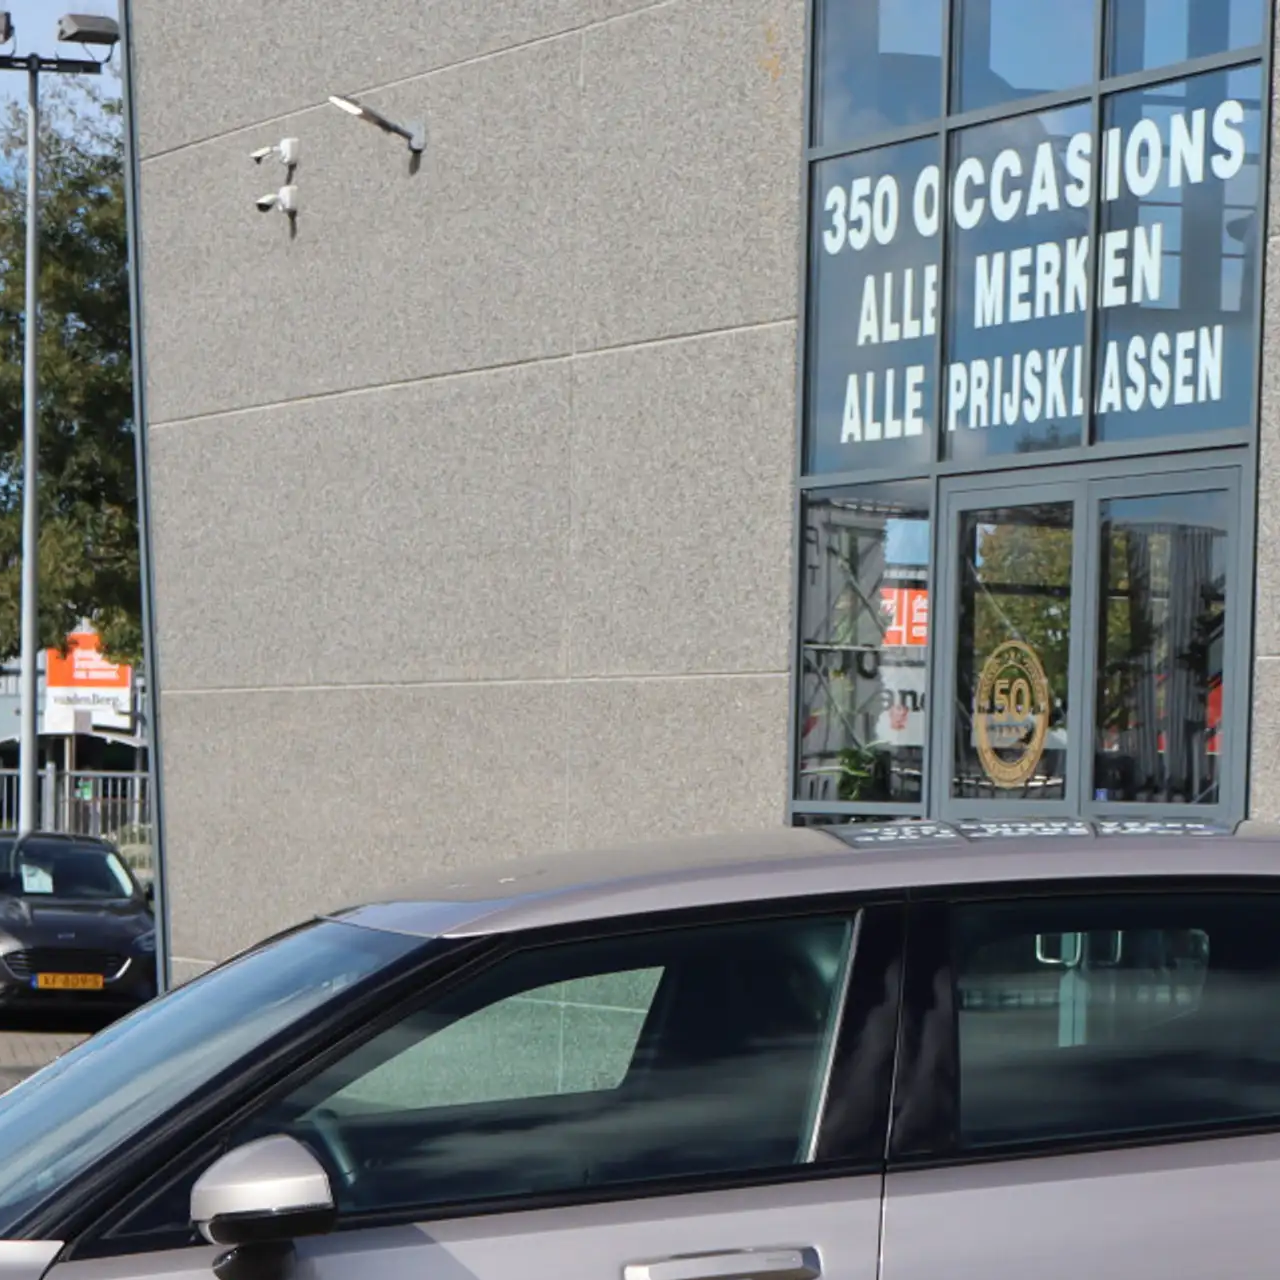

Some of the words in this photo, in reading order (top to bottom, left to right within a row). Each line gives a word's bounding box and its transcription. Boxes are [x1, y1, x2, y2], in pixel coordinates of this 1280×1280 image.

[823, 173, 899, 255] 350
[913, 100, 1245, 237] OCCASIONS
[857, 263, 937, 346] ALLE
[974, 222, 1163, 329] MERKEN
[840, 364, 924, 444] ALLE
[993, 677, 1032, 721] 50
